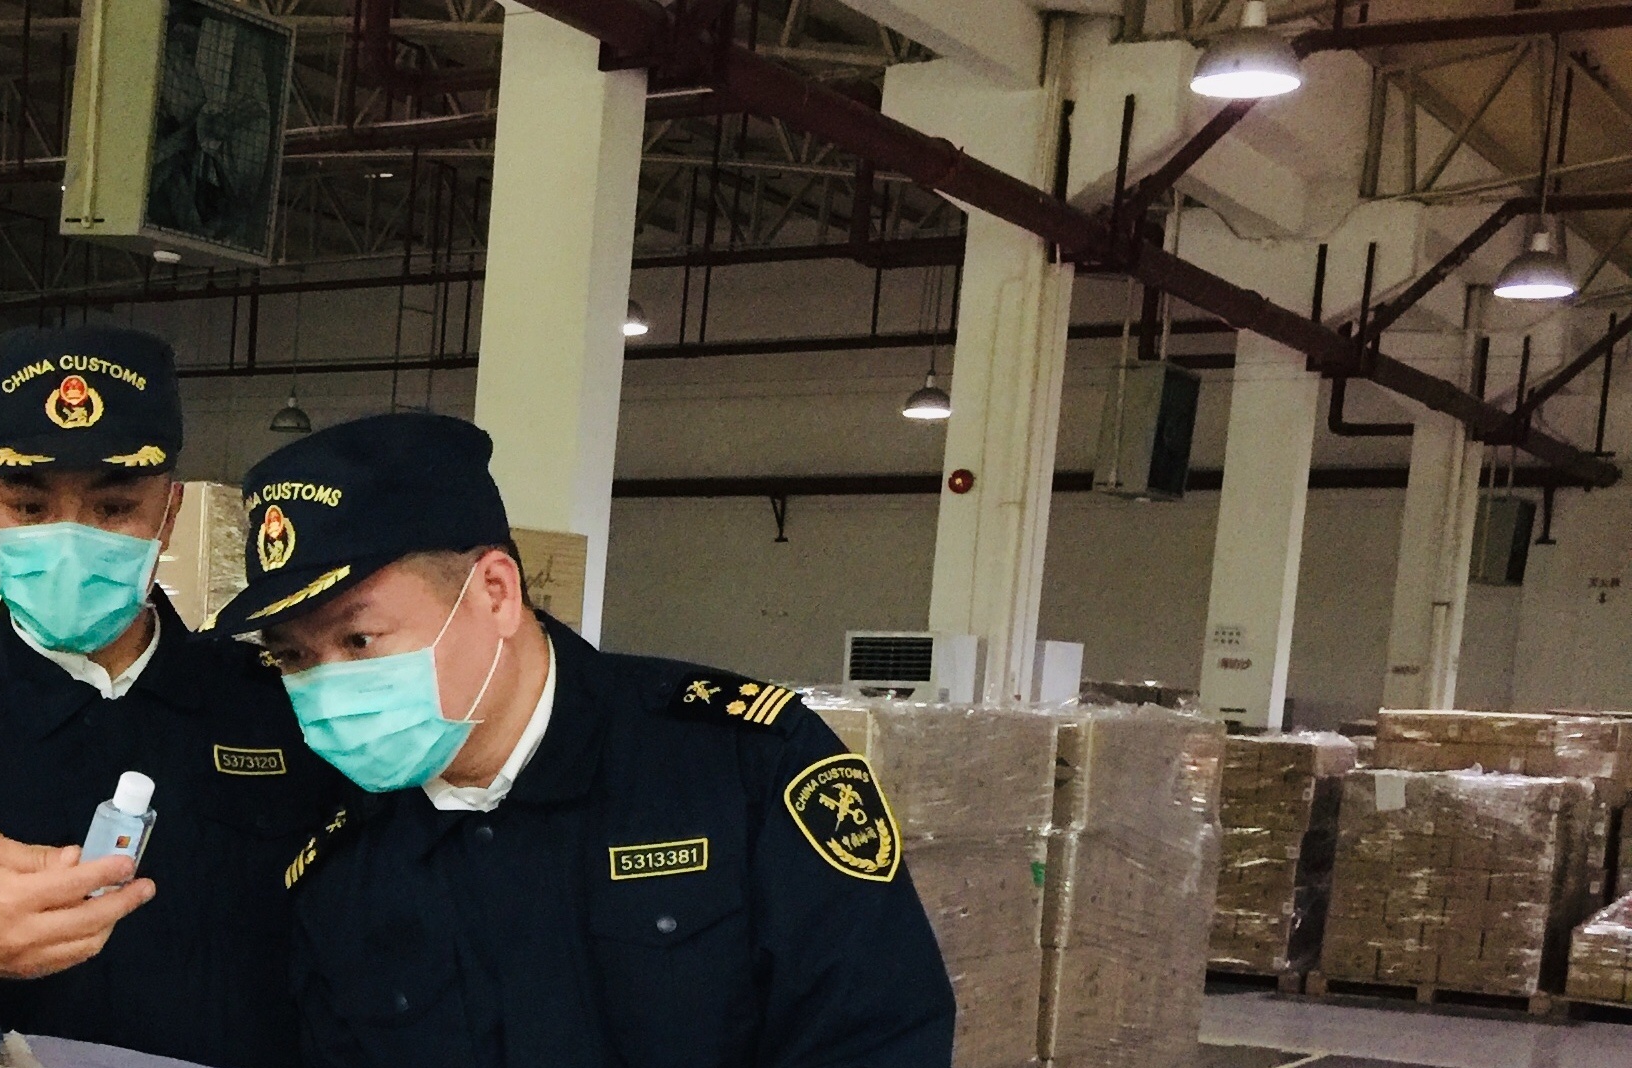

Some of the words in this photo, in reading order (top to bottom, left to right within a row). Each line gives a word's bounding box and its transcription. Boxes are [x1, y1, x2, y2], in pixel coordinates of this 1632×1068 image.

[1, 358, 55, 394] CHINA
[59, 354, 147, 391] CUSTOMS
[262, 482, 342, 507] CUSTOMS
[222, 753, 278, 770] 5373120
[795, 780, 819, 812] CHINA
[817, 767, 869, 784] CUSTOMS
[620, 847, 699, 871] 5313381
